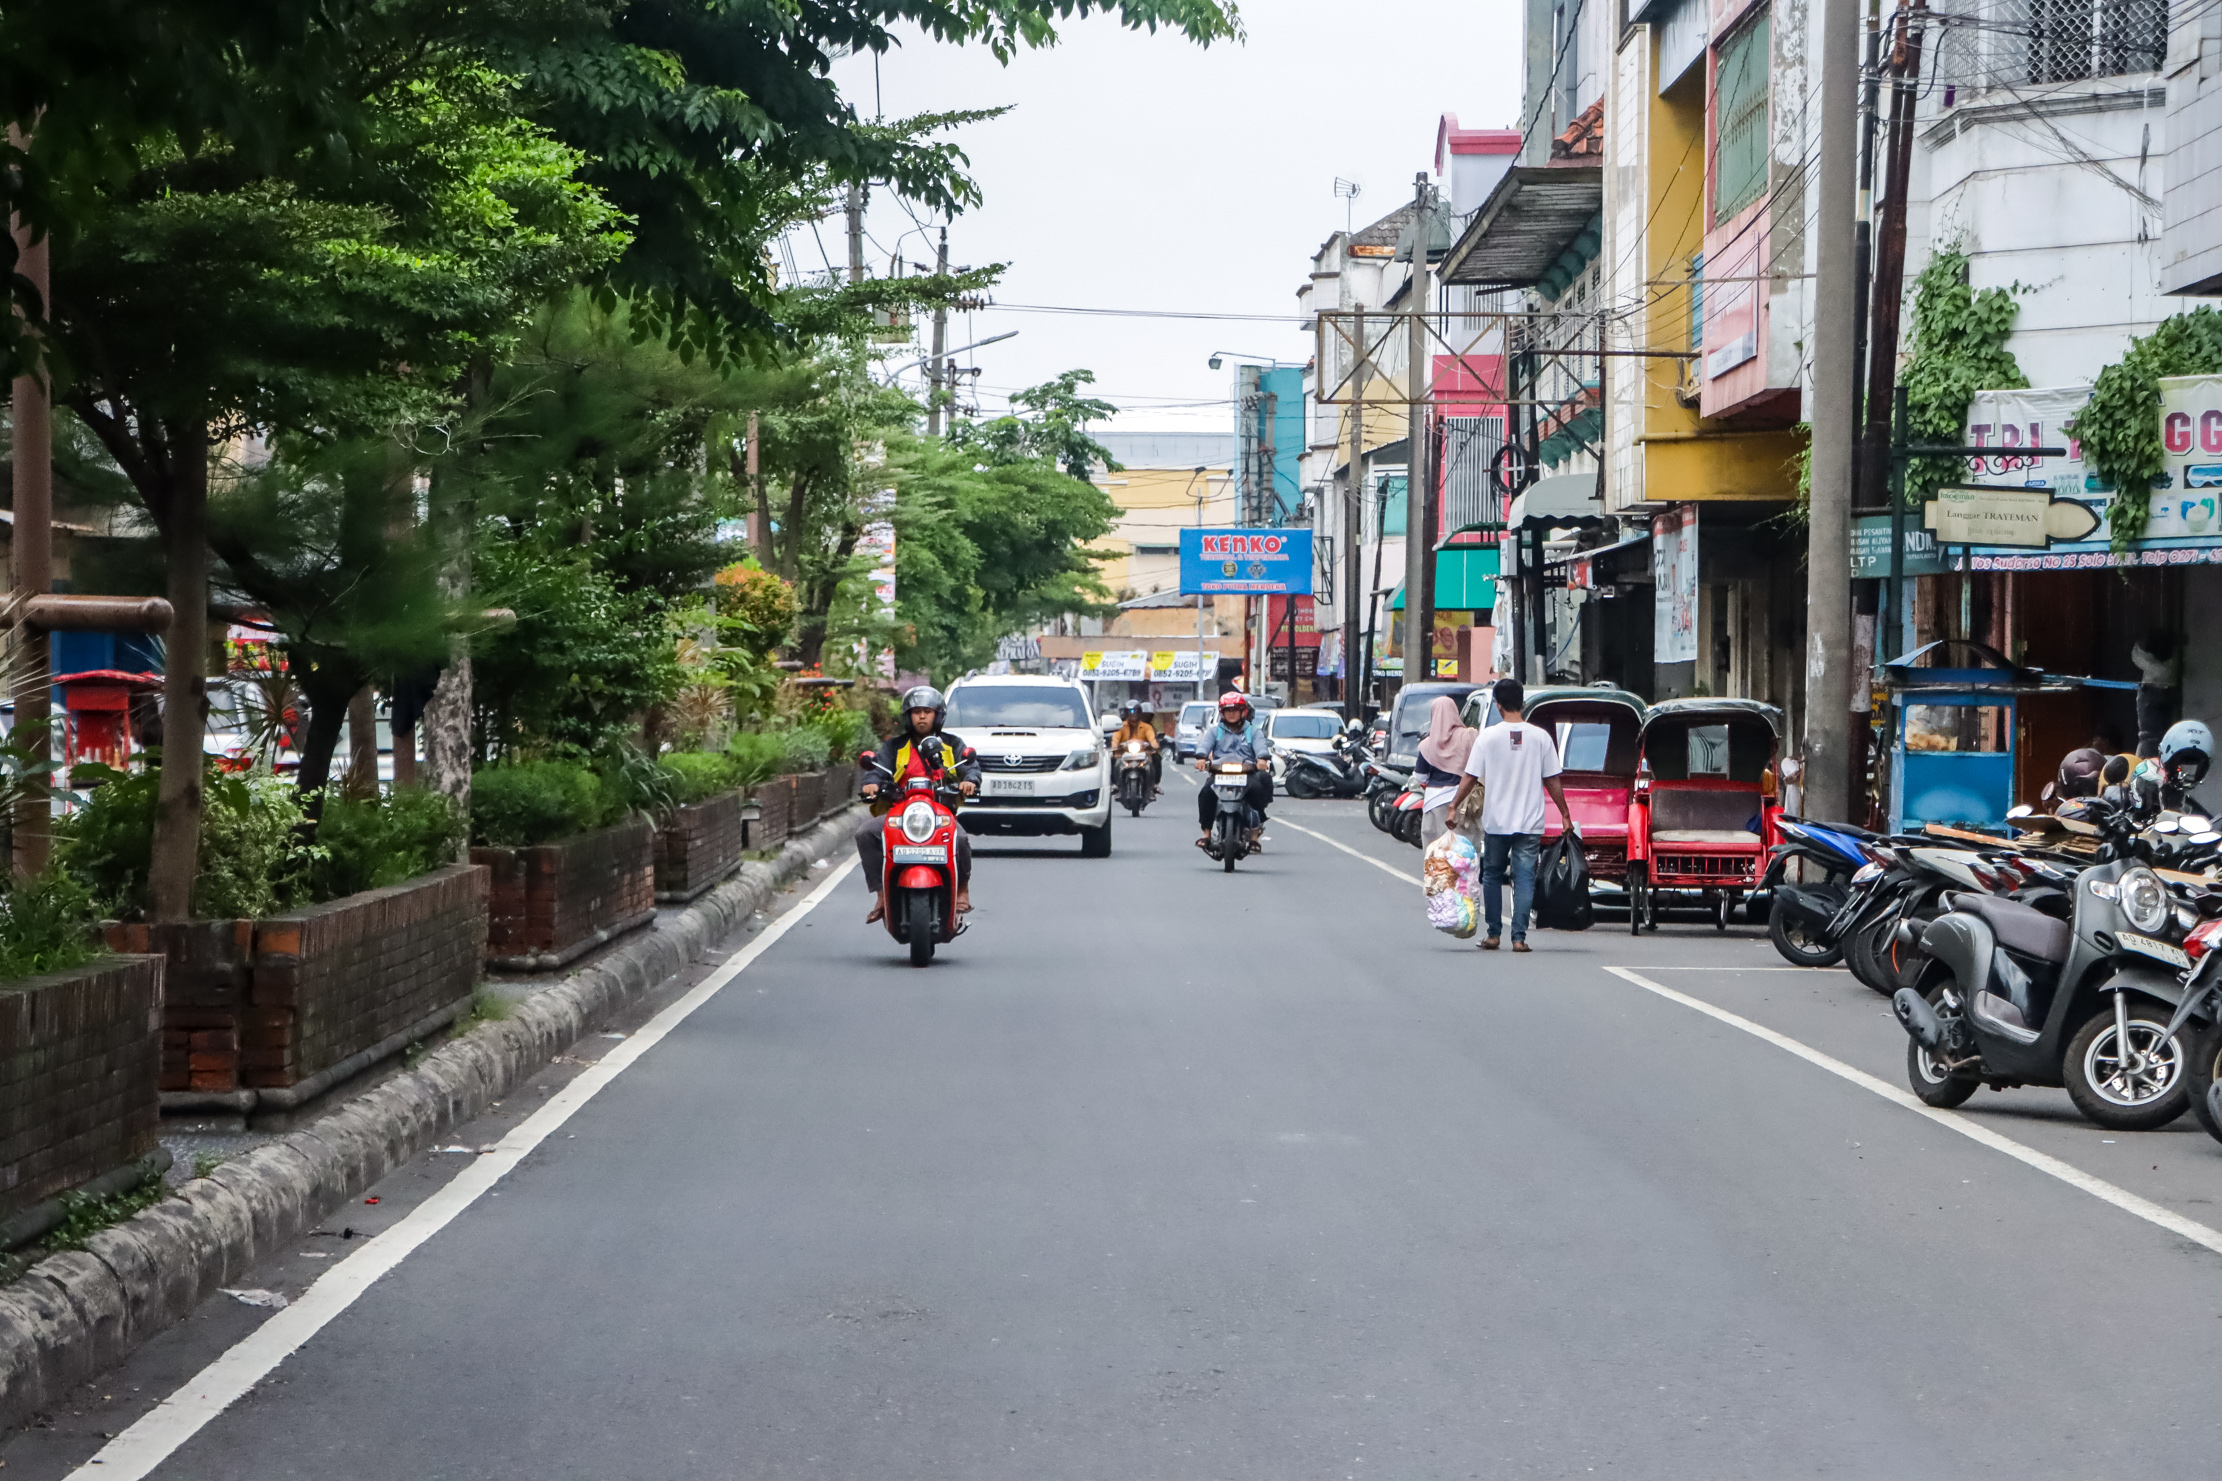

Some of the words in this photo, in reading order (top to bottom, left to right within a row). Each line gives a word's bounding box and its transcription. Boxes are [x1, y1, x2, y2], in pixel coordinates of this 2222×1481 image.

[1947, 510, 1980, 520] Langgar
[1983, 512, 2039, 522] TRAYEMAN
[1202, 534, 1282, 554] KENKO
[1971, 556, 1992, 570] Yos
[1992, 555, 2041, 570] Sudarso
[2043, 556, 2061, 569] No
[2062, 554, 2077, 567] 25
[2078, 553, 2106, 567] Solo
[2141, 550, 2168, 566] Telp
[2169, 549, 2198, 563] 0271
[1202, 583, 1222, 591] TOKO
[1223, 583, 1248, 591] PUTRA
[1249, 583, 1287, 591] MERDEKA
[1101, 660, 1125, 668] SUGIH
[1173, 660, 1198, 669] SUGIH
[992, 780, 1002, 789] AD
[896, 848, 907, 856] AD
